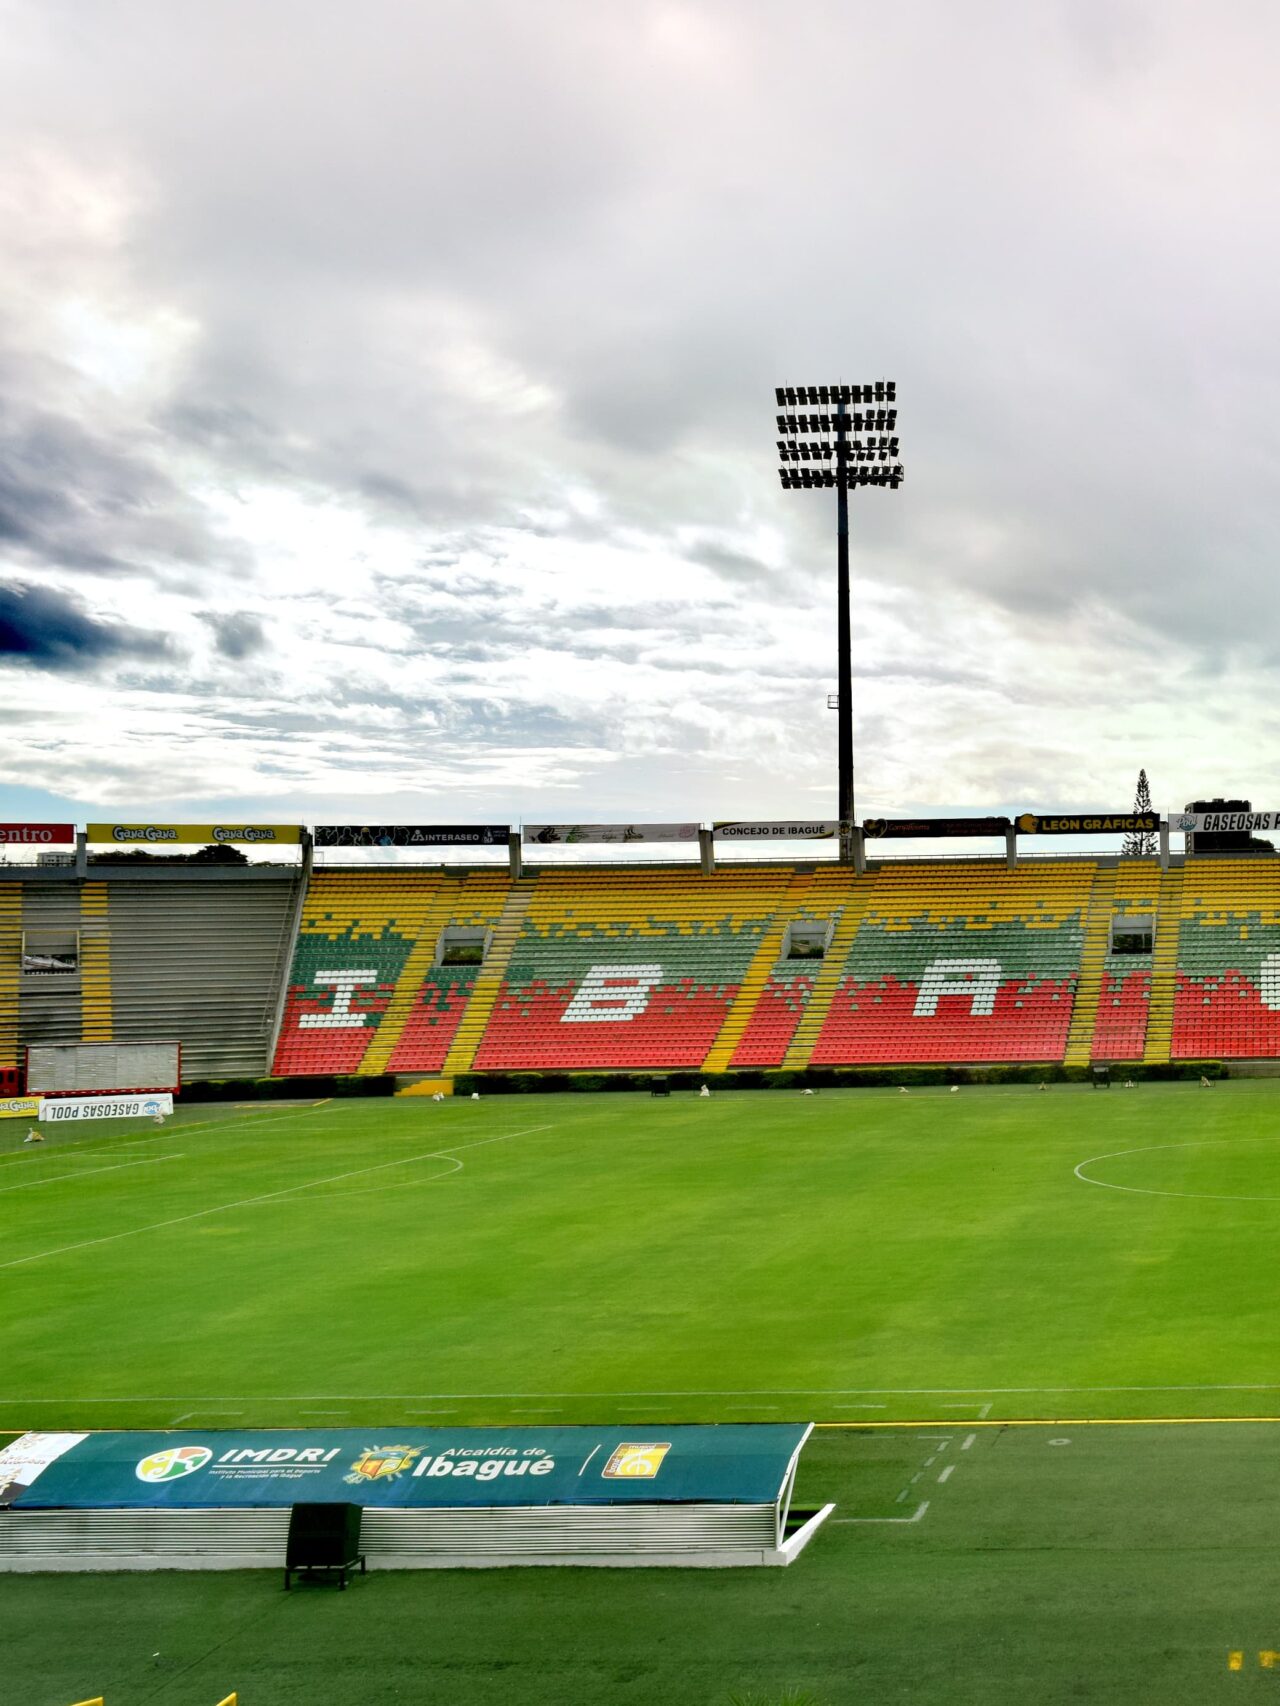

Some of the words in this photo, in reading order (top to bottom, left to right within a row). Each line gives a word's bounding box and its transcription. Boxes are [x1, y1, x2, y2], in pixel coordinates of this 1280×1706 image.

[1042, 817, 1081, 831] LEÓN
[1083, 815, 1154, 831] GRÁFICAS
[1203, 812, 1271, 831] GASEOSAS
[425, 833, 480, 841] INTERASEO
[722, 826, 769, 836] CONCEJO
[772, 826, 786, 835] DE
[788, 824, 825, 836] IBAGUÉ
[51, 1106, 79, 1119] POOL
[83, 1102, 140, 1118] GASEOSAS
[218, 1448, 341, 1462] IMDRI
[442, 1447, 519, 1457] Alcaldía
[523, 1447, 546, 1456] de
[412, 1454, 556, 1481] Ibagué
